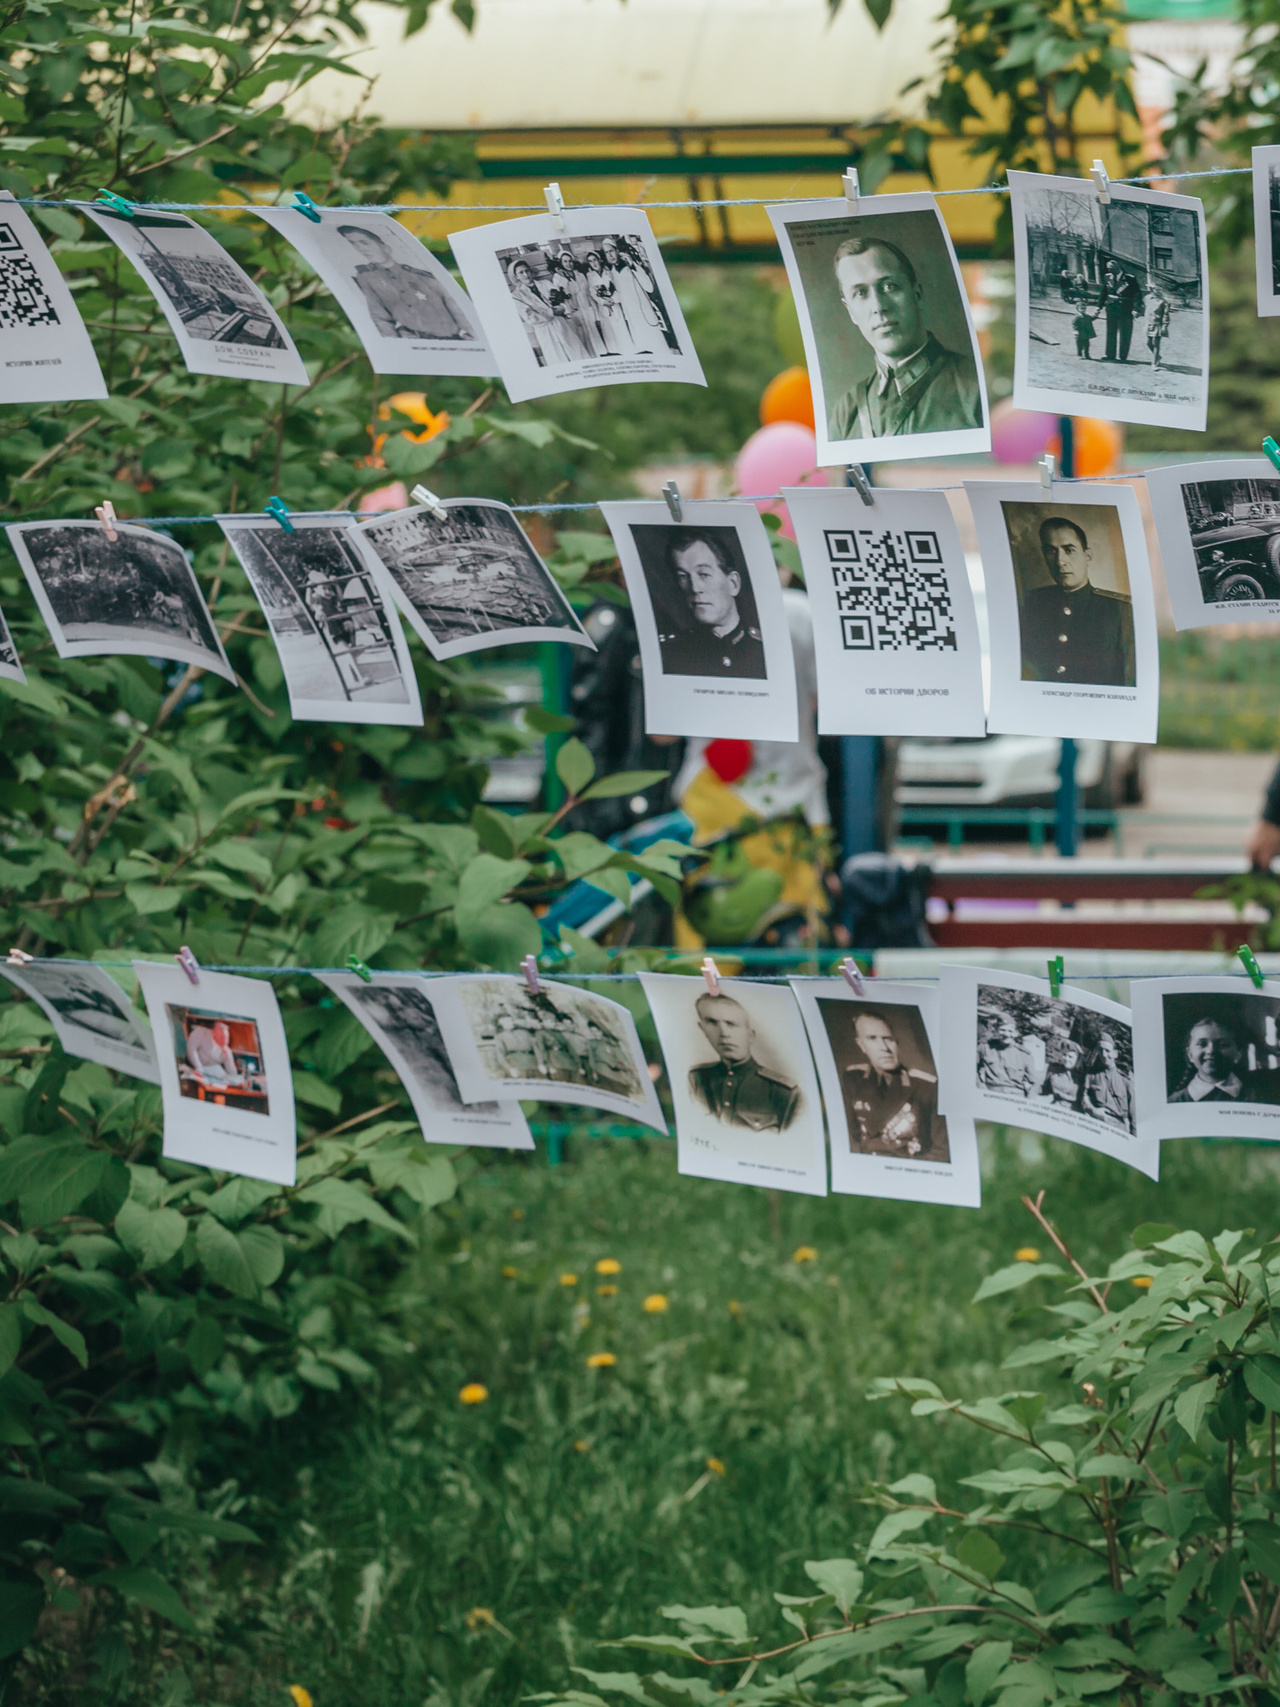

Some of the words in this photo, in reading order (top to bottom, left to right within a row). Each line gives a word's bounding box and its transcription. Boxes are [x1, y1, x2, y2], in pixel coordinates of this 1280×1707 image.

[865, 687, 877, 695] ОБ
[878, 688, 914, 696] ИСТОРИИ
[916, 688, 949, 696] ДВОРОВ
